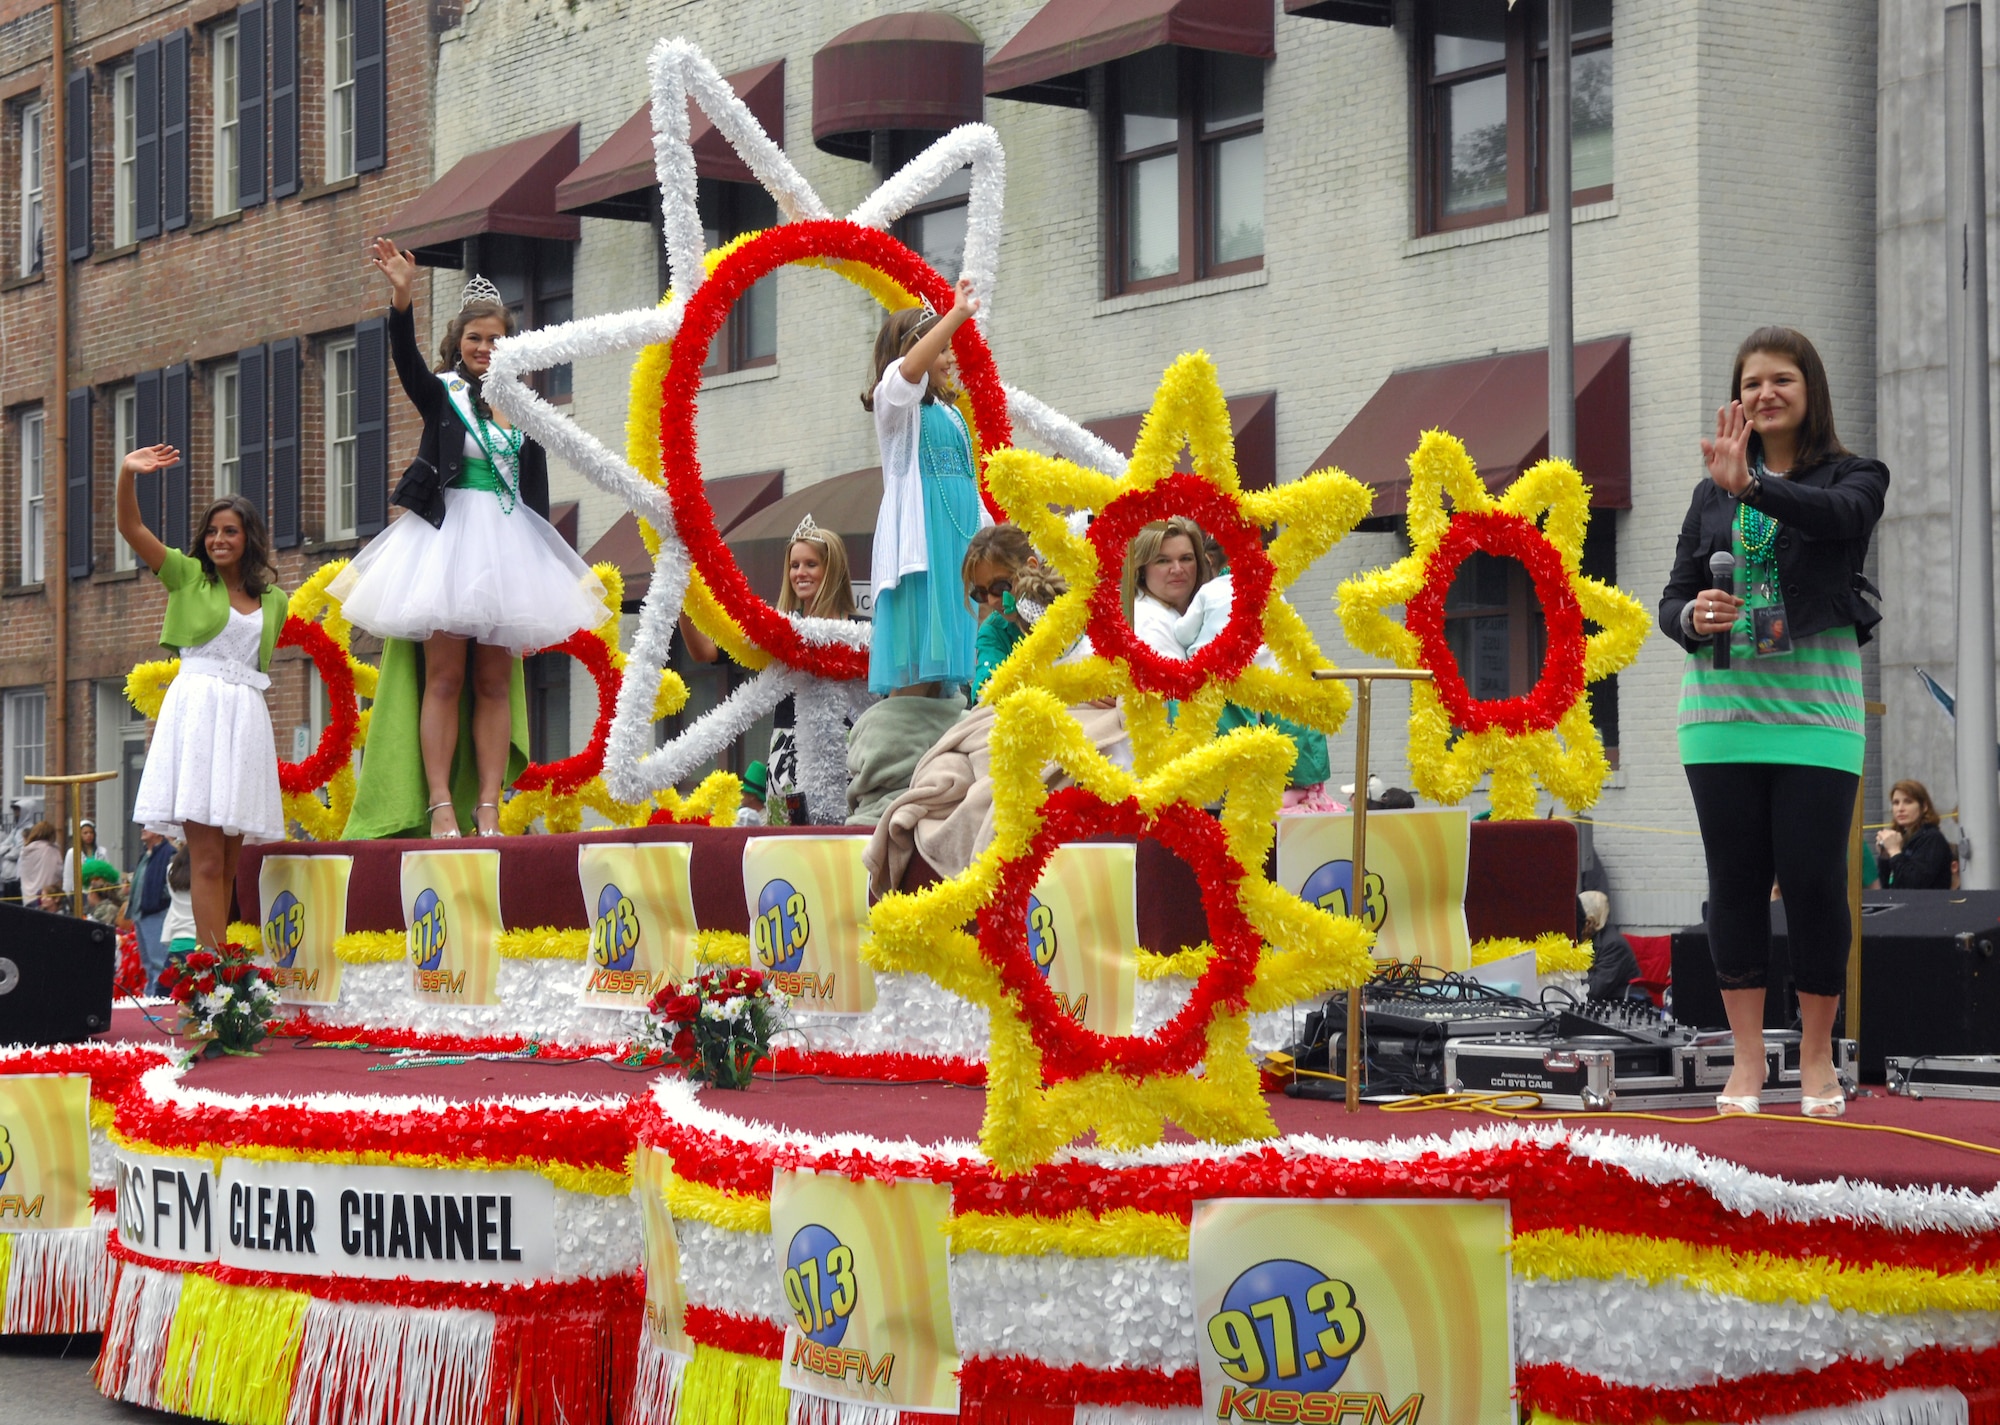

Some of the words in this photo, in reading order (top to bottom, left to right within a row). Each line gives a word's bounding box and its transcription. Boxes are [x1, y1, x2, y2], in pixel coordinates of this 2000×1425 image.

[264, 902, 305, 964] 97.3
[411, 899, 447, 967] 97.3
[593, 896, 640, 967] 97.3
[755, 892, 810, 968] 97.3
[586, 968, 665, 995] KISSFM
[1528, 1081, 1553, 1089] CASE
[152, 1168, 211, 1253] FM
[230, 1182, 316, 1254] CLEAR
[340, 1189, 521, 1261] CHANNEL
[783, 1244, 857, 1334] 97.3
[790, 1335, 895, 1387] KISSFM
[1207, 1279, 1366, 1384] 97.3
[1216, 1385, 1424, 1425] KISSFM
